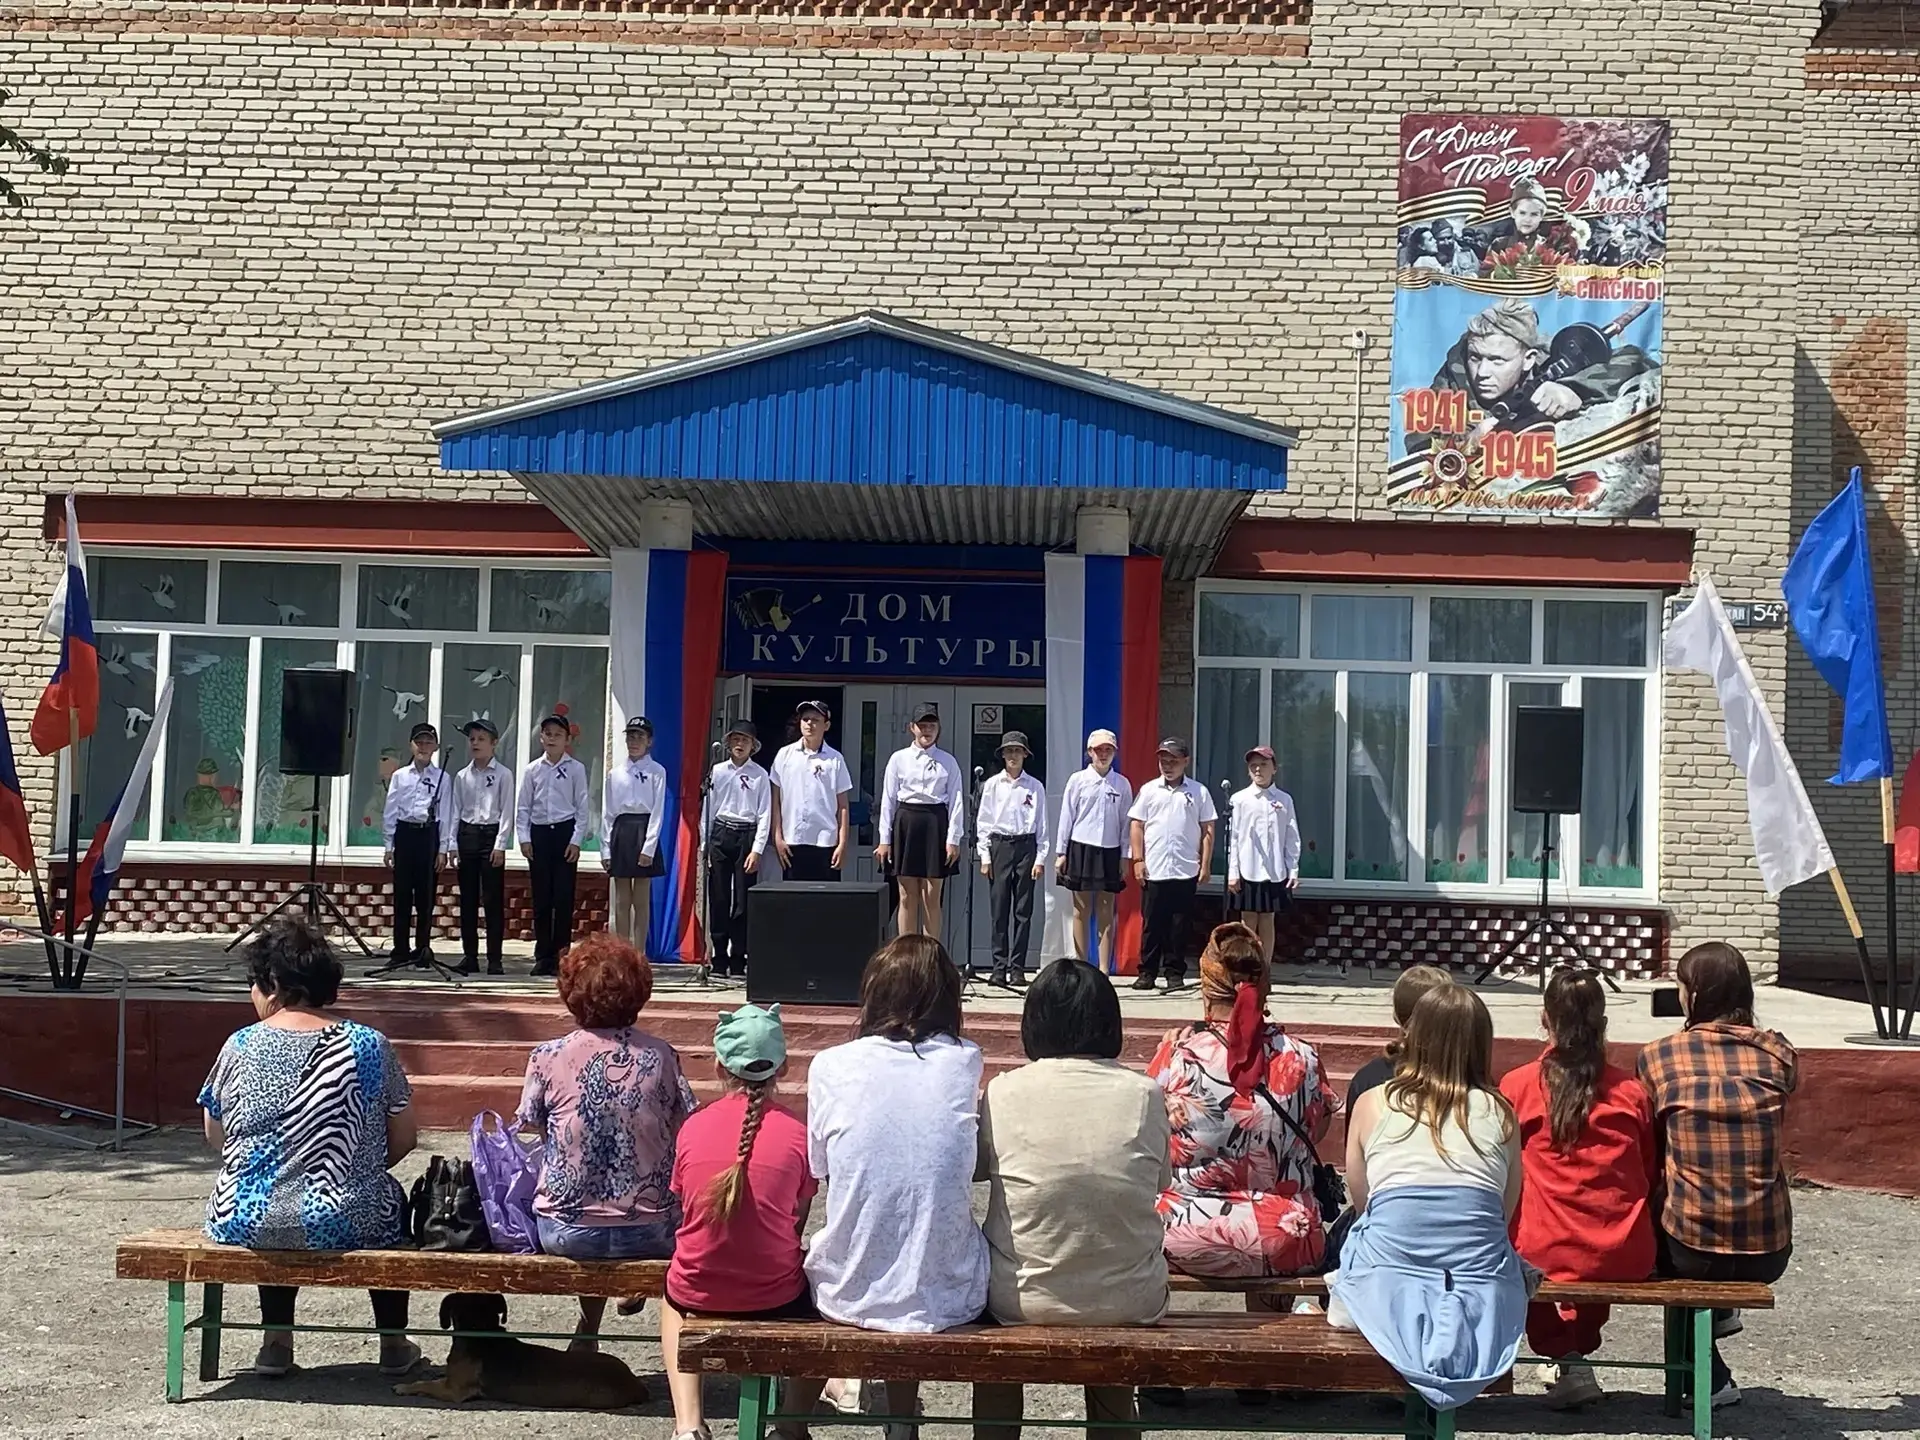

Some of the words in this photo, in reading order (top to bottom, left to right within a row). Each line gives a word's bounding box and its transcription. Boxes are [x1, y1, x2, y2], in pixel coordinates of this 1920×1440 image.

[1405, 127, 1432, 162] С
[1436, 121, 1518, 154] Днём
[1442, 147, 1575, 189] Победы!
[1564, 166, 1597, 214] 9
[1592, 193, 1650, 215] мая
[1576, 281, 1662, 300] СПАСИБО!
[1402, 389, 1483, 435] 1941-
[1480, 431, 1558, 479] 1945
[840, 593, 952, 626] ДОМ
[751, 633, 1042, 667] КУЛЬТУРЫ
